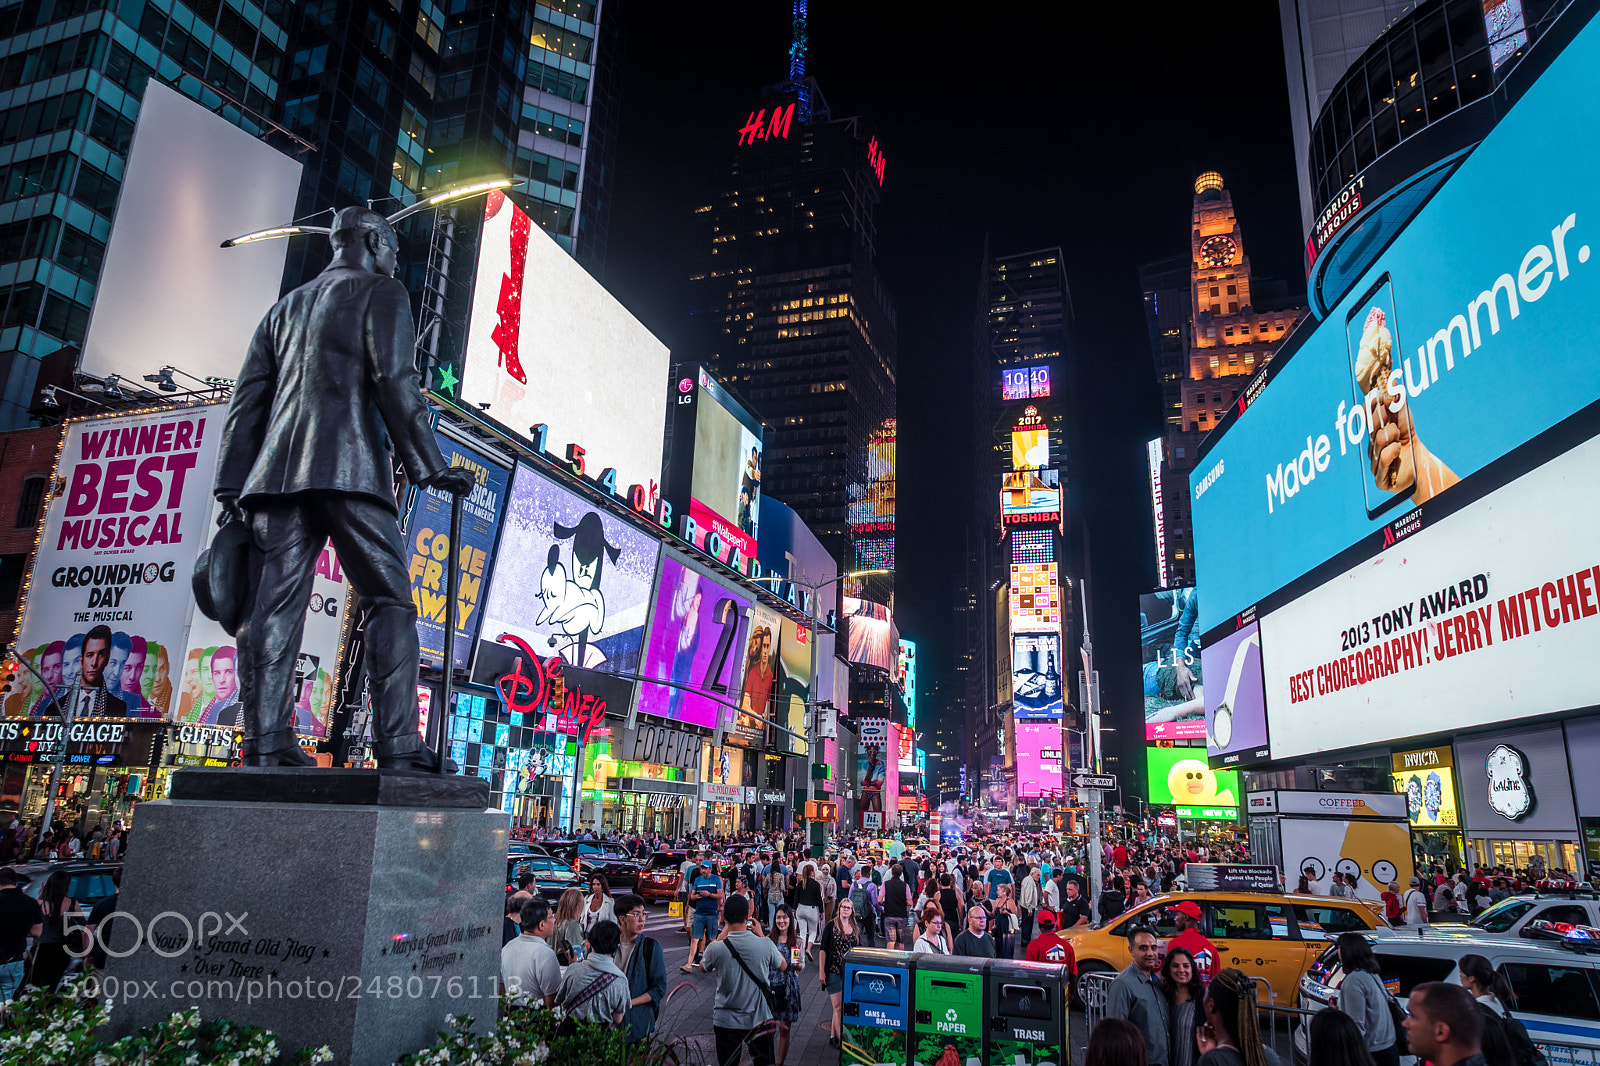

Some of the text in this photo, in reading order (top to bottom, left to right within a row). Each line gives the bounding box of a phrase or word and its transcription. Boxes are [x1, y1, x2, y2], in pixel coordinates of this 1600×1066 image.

[738, 103, 795, 146] H&M
[867, 135, 886, 187] H&M
[1316, 175, 1365, 235] MARRIOTT
[1318, 197, 1359, 248] MARQUIS
[1266, 212, 1591, 515] Made for summer.
[1005, 369, 1048, 386] 10:40
[1246, 369, 1268, 398] MARRIOTT
[678, 395, 692, 405] LG
[1247, 381, 1266, 407] MARQUIS
[1012, 423, 1048, 433] TOSHIBA
[1018, 416, 1042, 426] 2017
[81, 418, 207, 460] WINNER!
[64, 452, 198, 518] BEST
[1195, 459, 1225, 500] SAMSUNG
[1004, 511, 1059, 524] TOSHIBA
[1394, 508, 1423, 529] MARRIOTT
[57, 512, 183, 550] MUSICAL
[712, 520, 748, 551] #WallpaperTV
[1396, 520, 1420, 539] MARQUIS
[416, 527, 487, 577] COME
[51, 560, 176, 588] GROUNDHOG
[409, 553, 482, 604] FRM
[87, 586, 127, 609] DAY
[73, 610, 133, 623] THE MUSICAL
[1340, 624, 1371, 653] 2013
[1372, 602, 1414, 636] TONY
[1035, 644, 1058, 652] TOUR
[1156, 645, 1202, 669] LIS
[1289, 669, 1315, 704] BEST
[1317, 627, 1431, 697] CHOREOGRAPHY!
[1434, 603, 1493, 662] JERRY
[36, 741, 55, 752] NY
[179, 725, 233, 747] GIFTS
[633, 722, 702, 769] FOREVER
[9, 753, 33, 761] Canon
[70, 755, 90, 763] BOWER
[204, 758, 227, 767] Nikon
[1404, 750, 1440, 768] INVICTA
[707, 785, 716, 794] U.S.
[716, 786, 728, 795] POLO
[1202, 809, 1223, 817] NEW
[1318, 798, 1366, 807] COFFEED
[866, 813, 879, 823] hi.
[205, 936, 251, 956] Grand
[255, 938, 280, 957] Old
[281, 938, 317, 964] Flag
[390, 934, 418, 957] Mary's
[425, 930, 450, 953] Grand
[451, 925, 465, 943] Old
[466, 923, 487, 940] Name
[193, 956, 264, 978] Over There
[420, 952, 457, 971] Harrigan
[864, 1010, 880, 1018] CANS
[876, 1017, 901, 1027] BOTTLES
[937, 1021, 966, 1034] PAPER
[1013, 1028, 1045, 1041] TRASH
